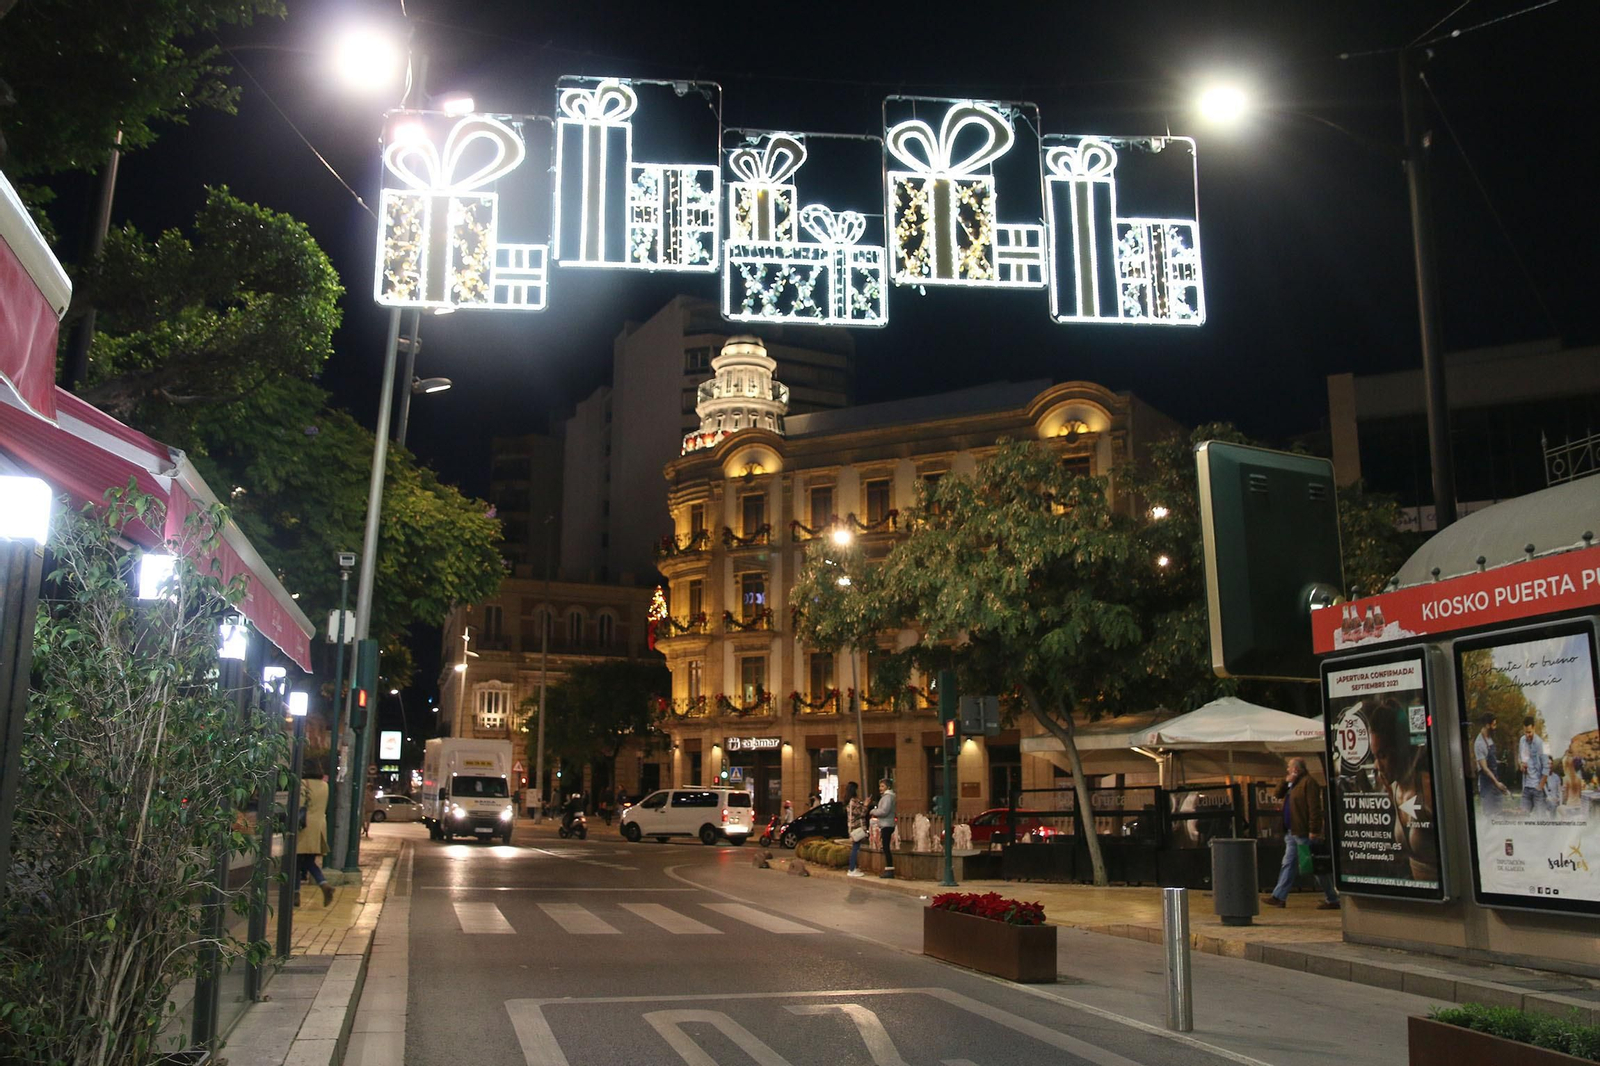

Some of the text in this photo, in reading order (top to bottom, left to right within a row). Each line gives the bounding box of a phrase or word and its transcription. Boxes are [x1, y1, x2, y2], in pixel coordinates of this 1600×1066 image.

[1421, 590, 1489, 621] KIOSKO
[1494, 573, 1576, 607] PUERTA
[1541, 655, 1578, 667] bueno
[1370, 667, 1415, 680] CONFIRMADA!
[1351, 679, 1399, 691] SEPTIEMBRE 2021
[741, 737, 780, 750] cajamar
[1338, 729, 1356, 750] 19
[1343, 797, 1391, 810] TU NUEVO
[1343, 812, 1391, 826] GIMNASIO
[1344, 830, 1359, 838] ALTA
[1360, 831, 1382, 839] ONLINE
[1341, 840, 1402, 852] www.synergym.es
